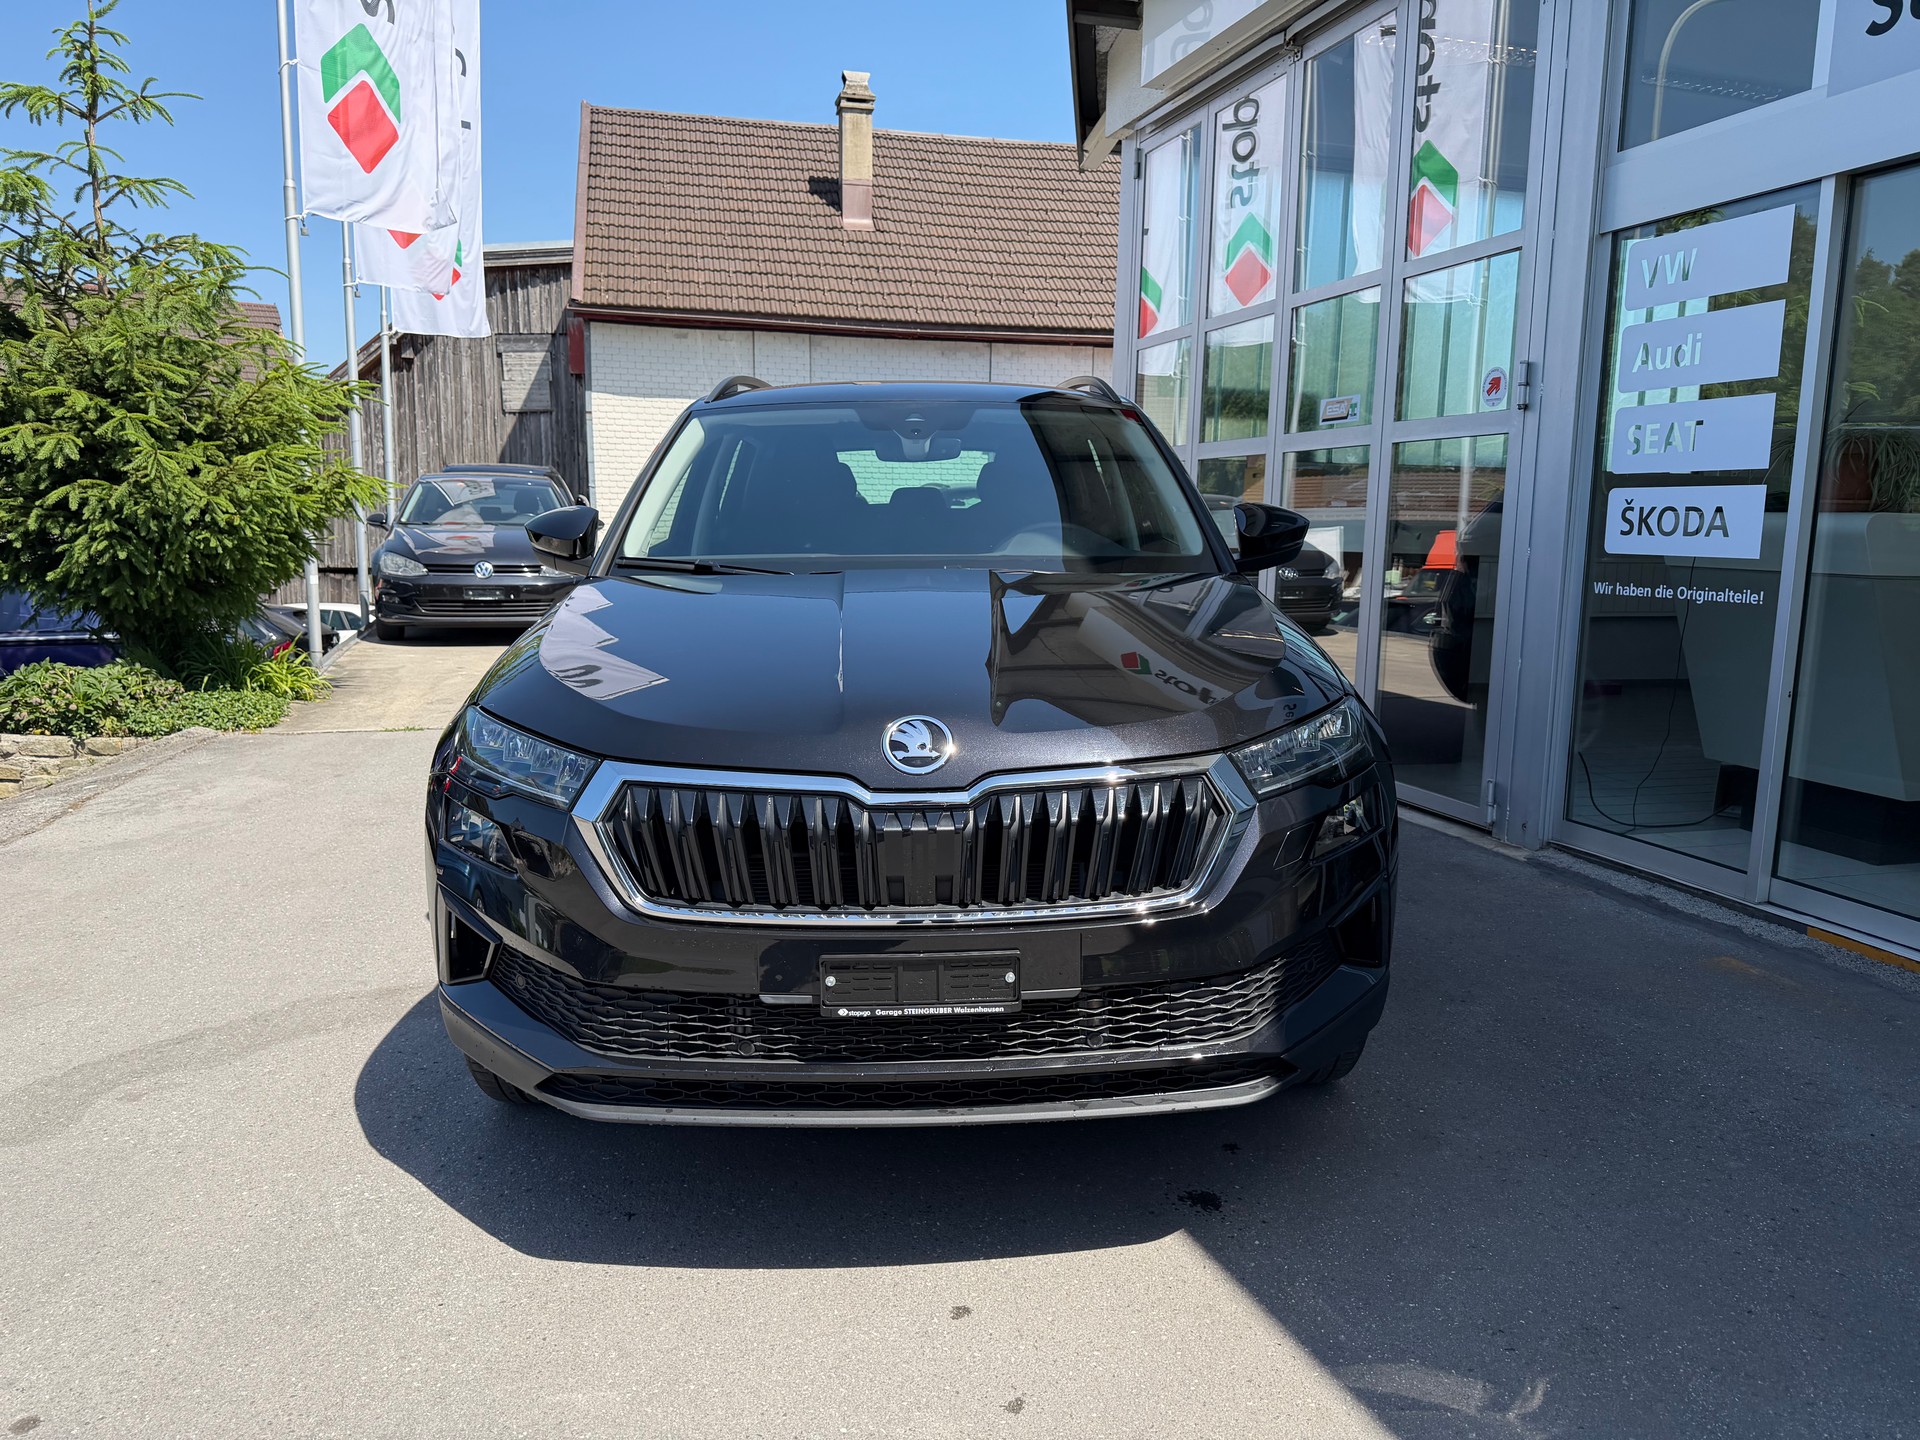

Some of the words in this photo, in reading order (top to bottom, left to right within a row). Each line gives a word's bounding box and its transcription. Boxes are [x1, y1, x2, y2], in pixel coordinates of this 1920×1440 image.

[1641, 247, 1698, 289] VW
[1631, 332, 1703, 373] Audi
[1626, 419, 1704, 456] SEAT
[1619, 498, 1730, 538] ŠKODA
[1593, 581, 1614, 595] Wir
[1615, 582, 1652, 598] haben
[1654, 584, 1674, 599] die
[1677, 586, 1764, 605] Originalteile!
[875, 1009, 903, 1017] Garage
